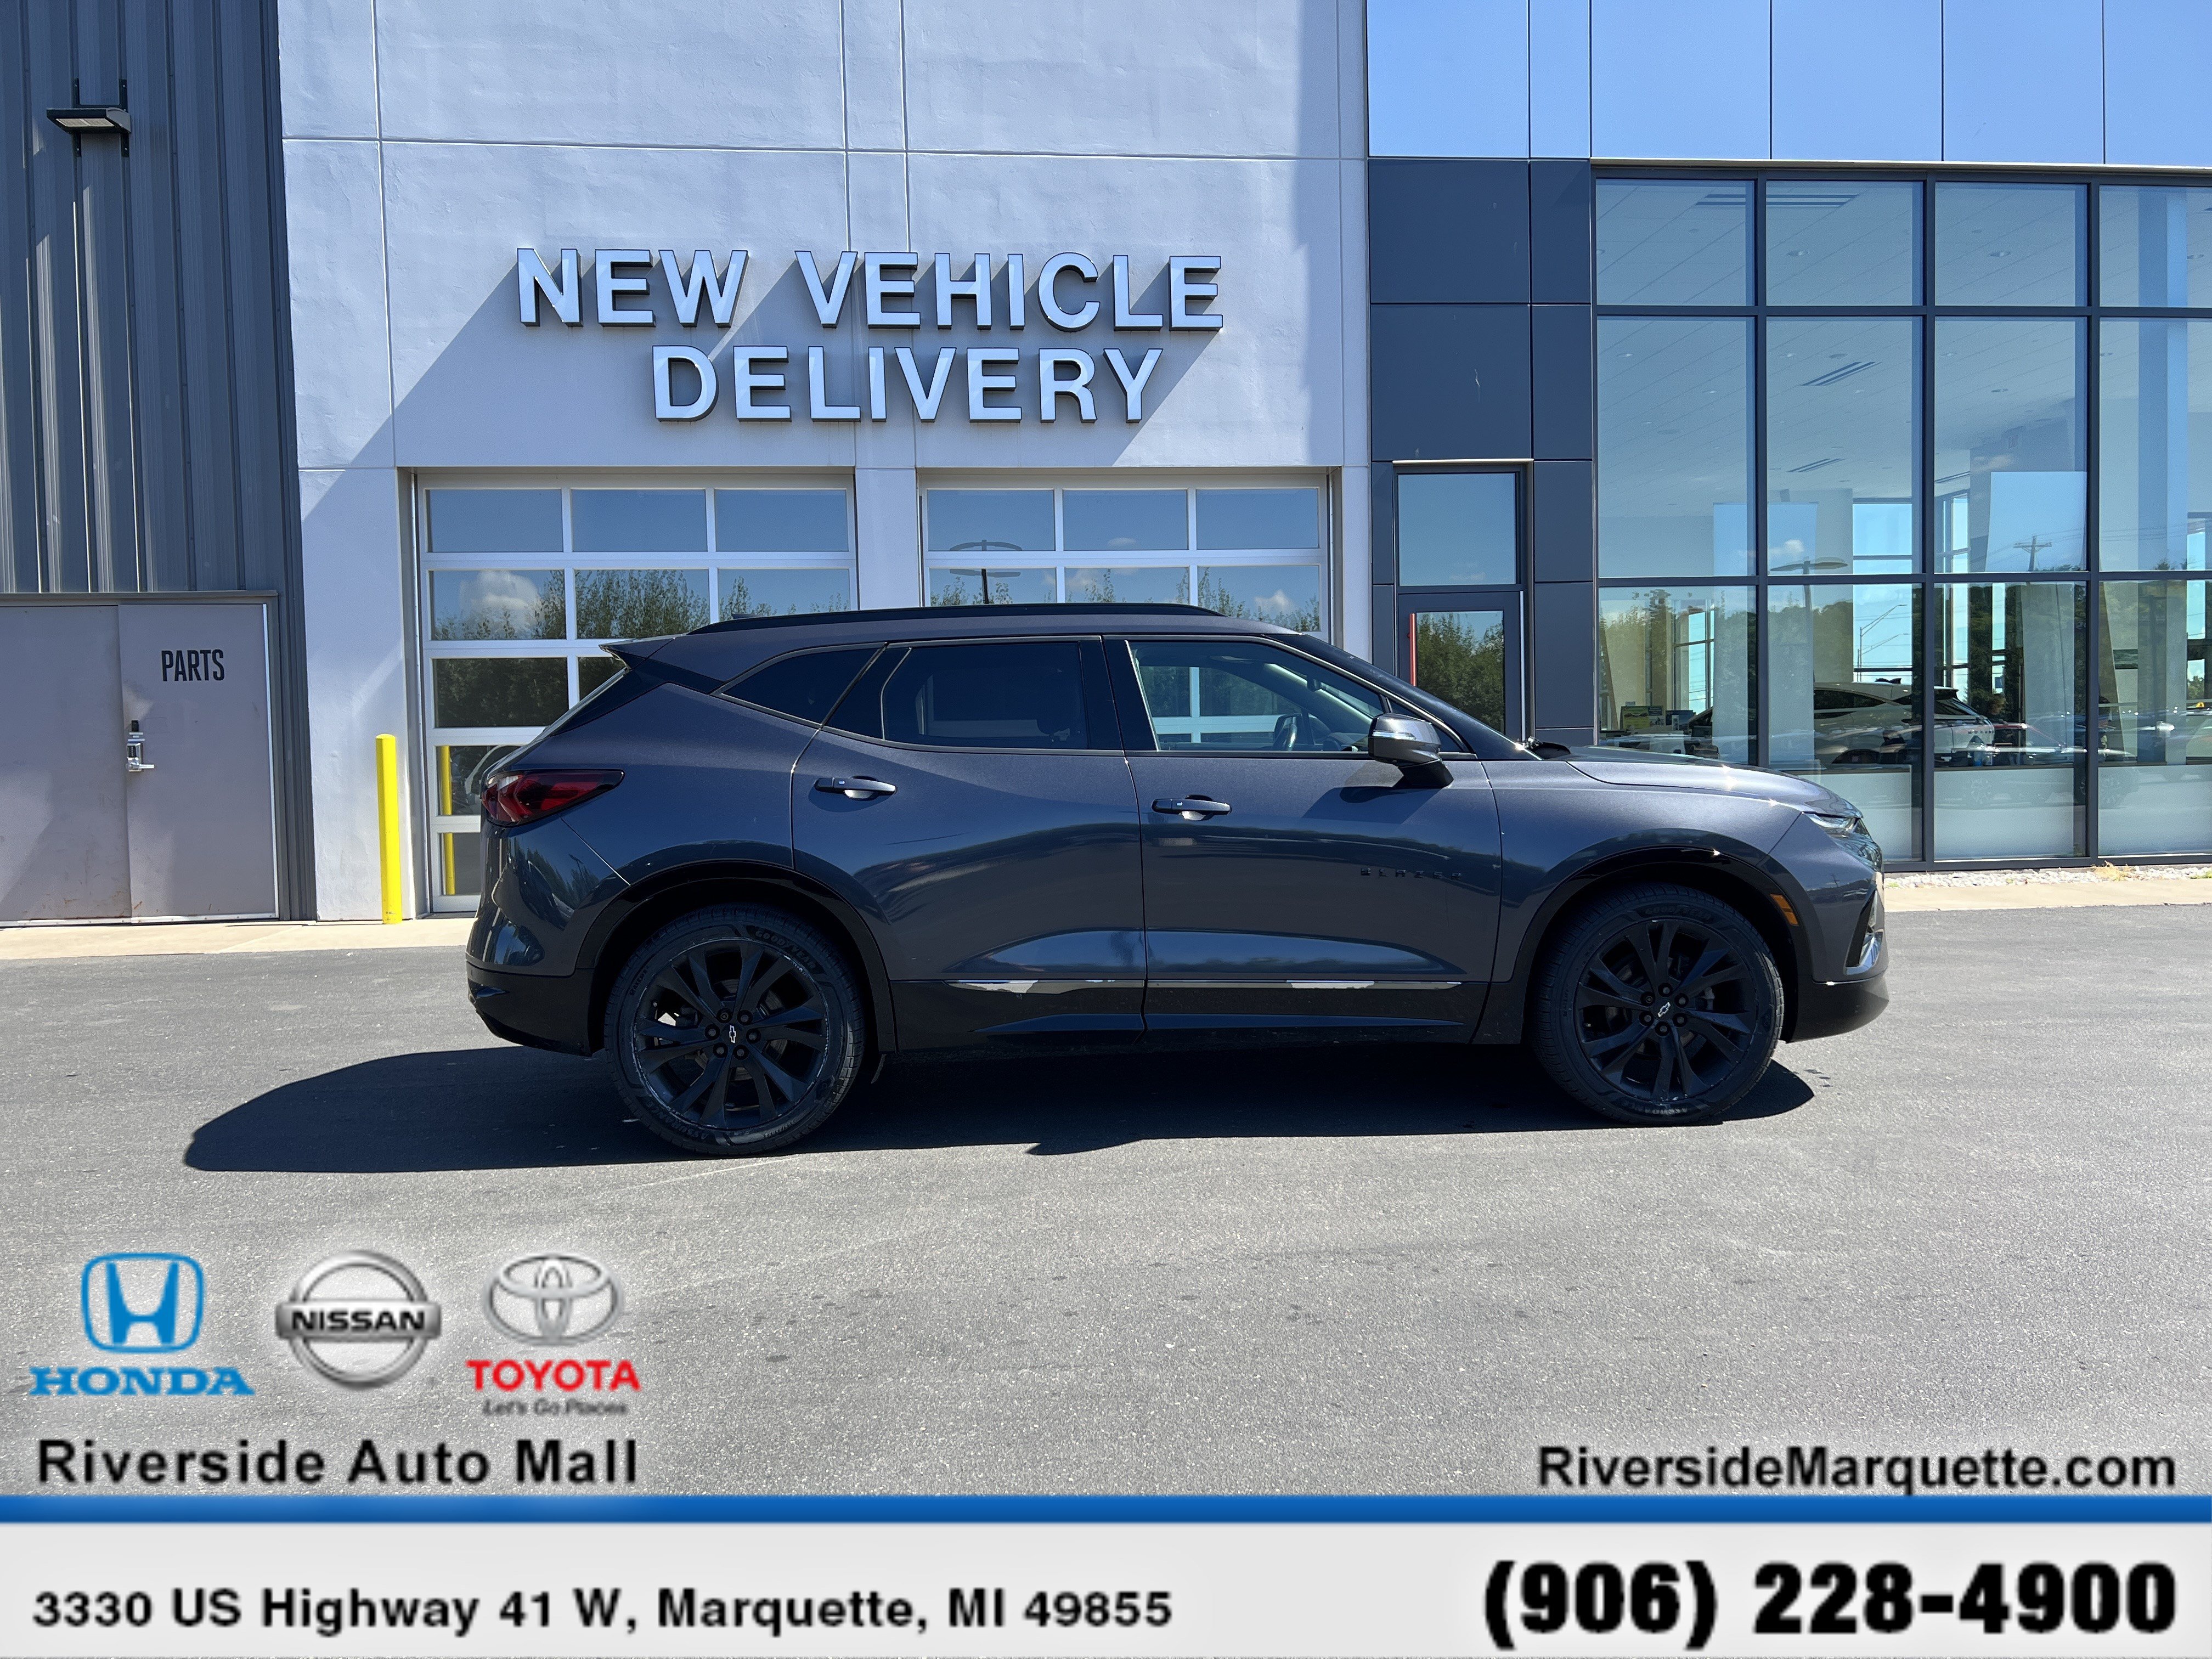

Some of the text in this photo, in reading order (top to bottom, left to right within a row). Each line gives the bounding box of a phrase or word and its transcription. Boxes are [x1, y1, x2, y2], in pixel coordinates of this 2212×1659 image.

[517, 247, 1223, 332] NEW VEHICLE
[652, 345, 1164, 424] DELIVERY
[161, 648, 225, 682] PARTS
[1361, 867, 1462, 881] BLAZER
[755, 929, 817, 970] GOODYEAR
